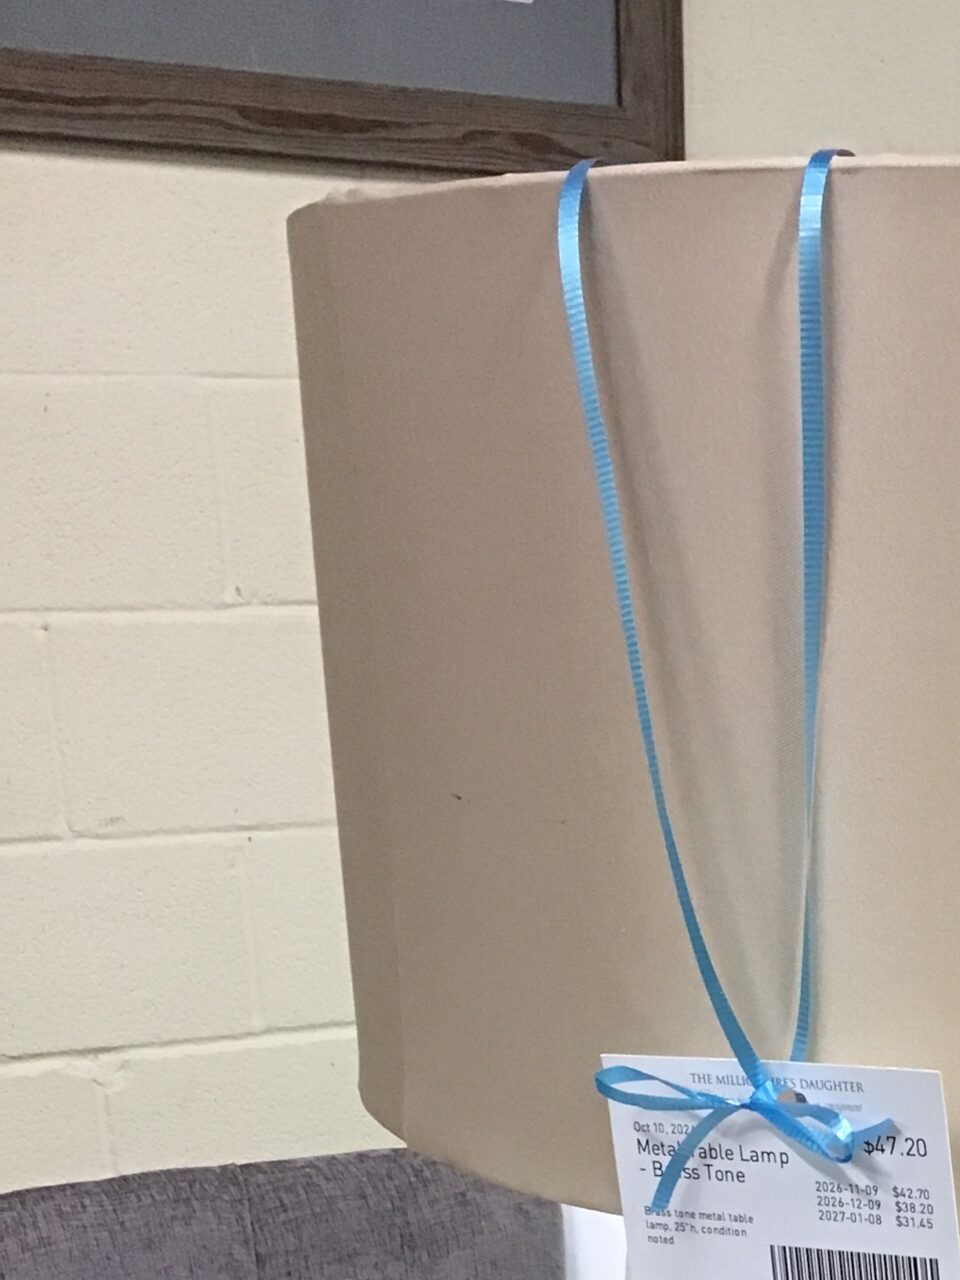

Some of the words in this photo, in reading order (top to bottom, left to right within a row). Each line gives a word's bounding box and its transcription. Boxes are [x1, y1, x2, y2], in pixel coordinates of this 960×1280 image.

[690, 1073, 712, 1085] THE
[800, 1079, 865, 1094] DAUGHTER
[633, 1121, 651, 1133] Oct
[653, 1122, 669, 1136] 10,
[690, 1142, 735, 1161] able
[739, 1144, 790, 1168] Lamp
[863, 1135, 928, 1158] $47.20
[652, 1160, 701, 1180] Bss
[703, 1164, 746, 1183] Tone
[815, 1181, 879, 1196] 2026-11-09
[892, 1186, 930, 1201] $42.70
[816, 1195, 881, 1211] 2026-12-09
[894, 1201, 934, 1215] $38.20
[674, 1208, 695, 1219] tone
[698, 1210, 726, 1222] metal
[729, 1213, 754, 1224] table
[818, 1209, 882, 1225] 2027-01-08
[647, 1234, 675, 1245] noted
[701, 1224, 748, 1237] condition
